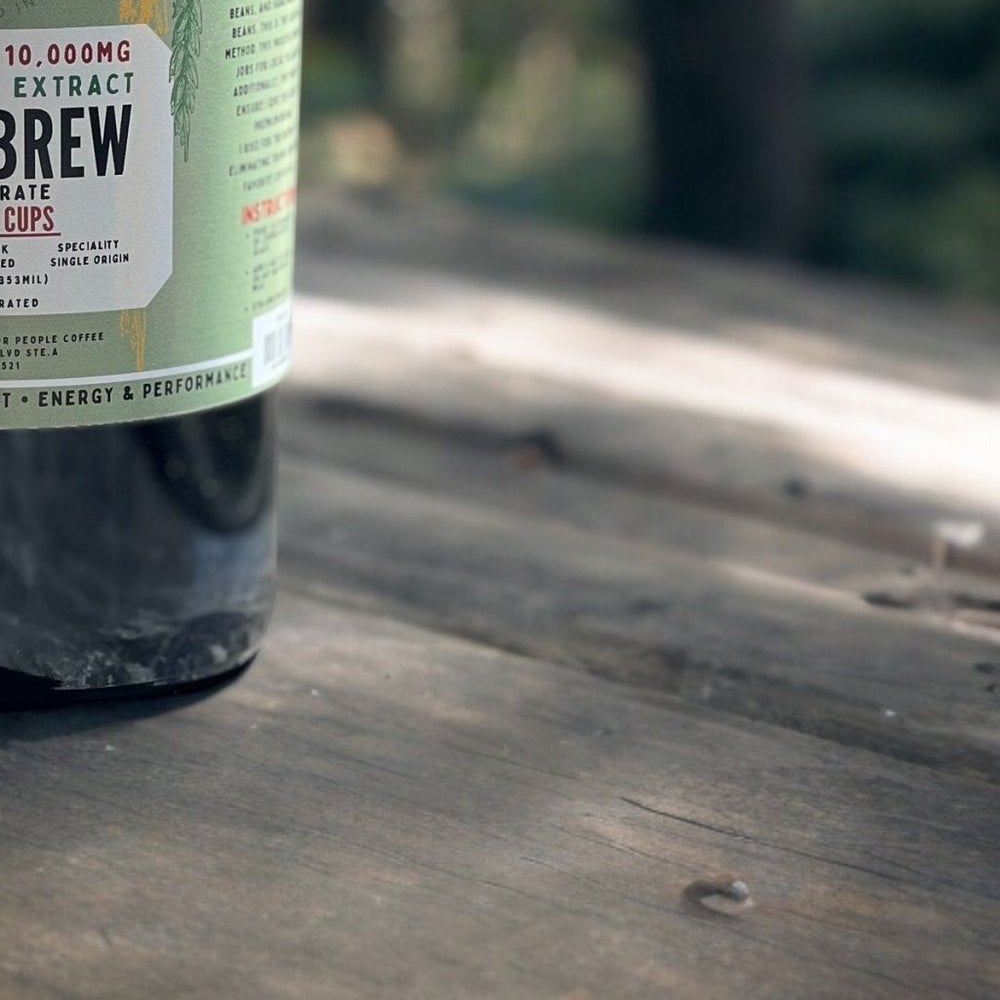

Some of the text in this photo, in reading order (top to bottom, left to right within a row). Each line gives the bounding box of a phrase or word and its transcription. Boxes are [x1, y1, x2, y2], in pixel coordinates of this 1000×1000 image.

[5, 40, 131, 67] 10,000MG
[225, 44, 256, 60] METHOD
[14, 72, 135, 97] EXTRACT
[4, 205, 56, 232] CUPS
[57, 239, 119, 253] SPECIALITY
[50, 253, 129, 268] SINGLE ORIGIN
[15, 335, 57, 344] PEOPLE
[63, 332, 105, 343] COFFEE
[26, 347, 59, 357] STE.A
[38, 387, 114, 407] ENERGY
[123, 386, 134, 401] &
[143, 362, 247, 399] PERFORMANCE
